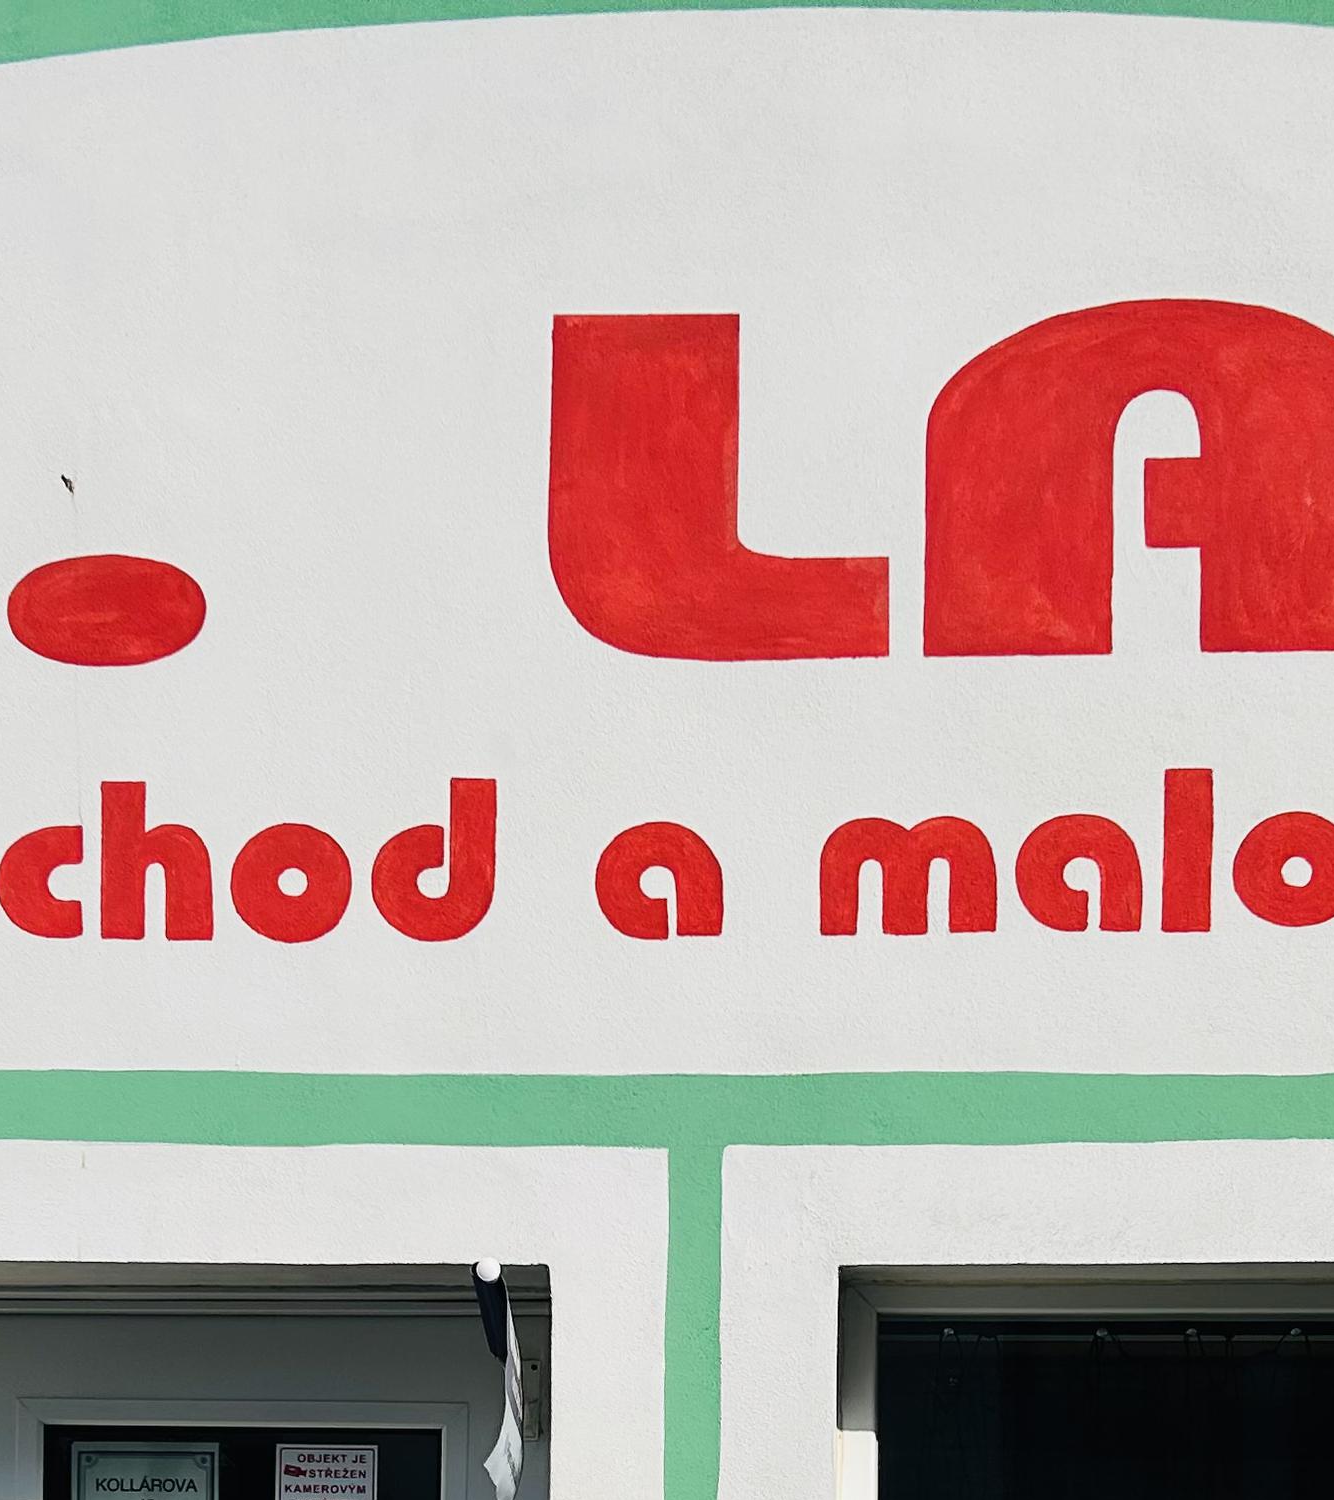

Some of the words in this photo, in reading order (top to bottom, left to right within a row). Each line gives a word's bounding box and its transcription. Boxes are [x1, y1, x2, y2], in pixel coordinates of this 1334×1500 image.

[595, 821, 724, 940] a
[297, 1454, 347, 1465] OBJEKT
[352, 1454, 367, 1465] JE
[308, 1467, 367, 1479] STŘEŽEN
[95, 1475, 198, 1493] KOLLÁROVA
